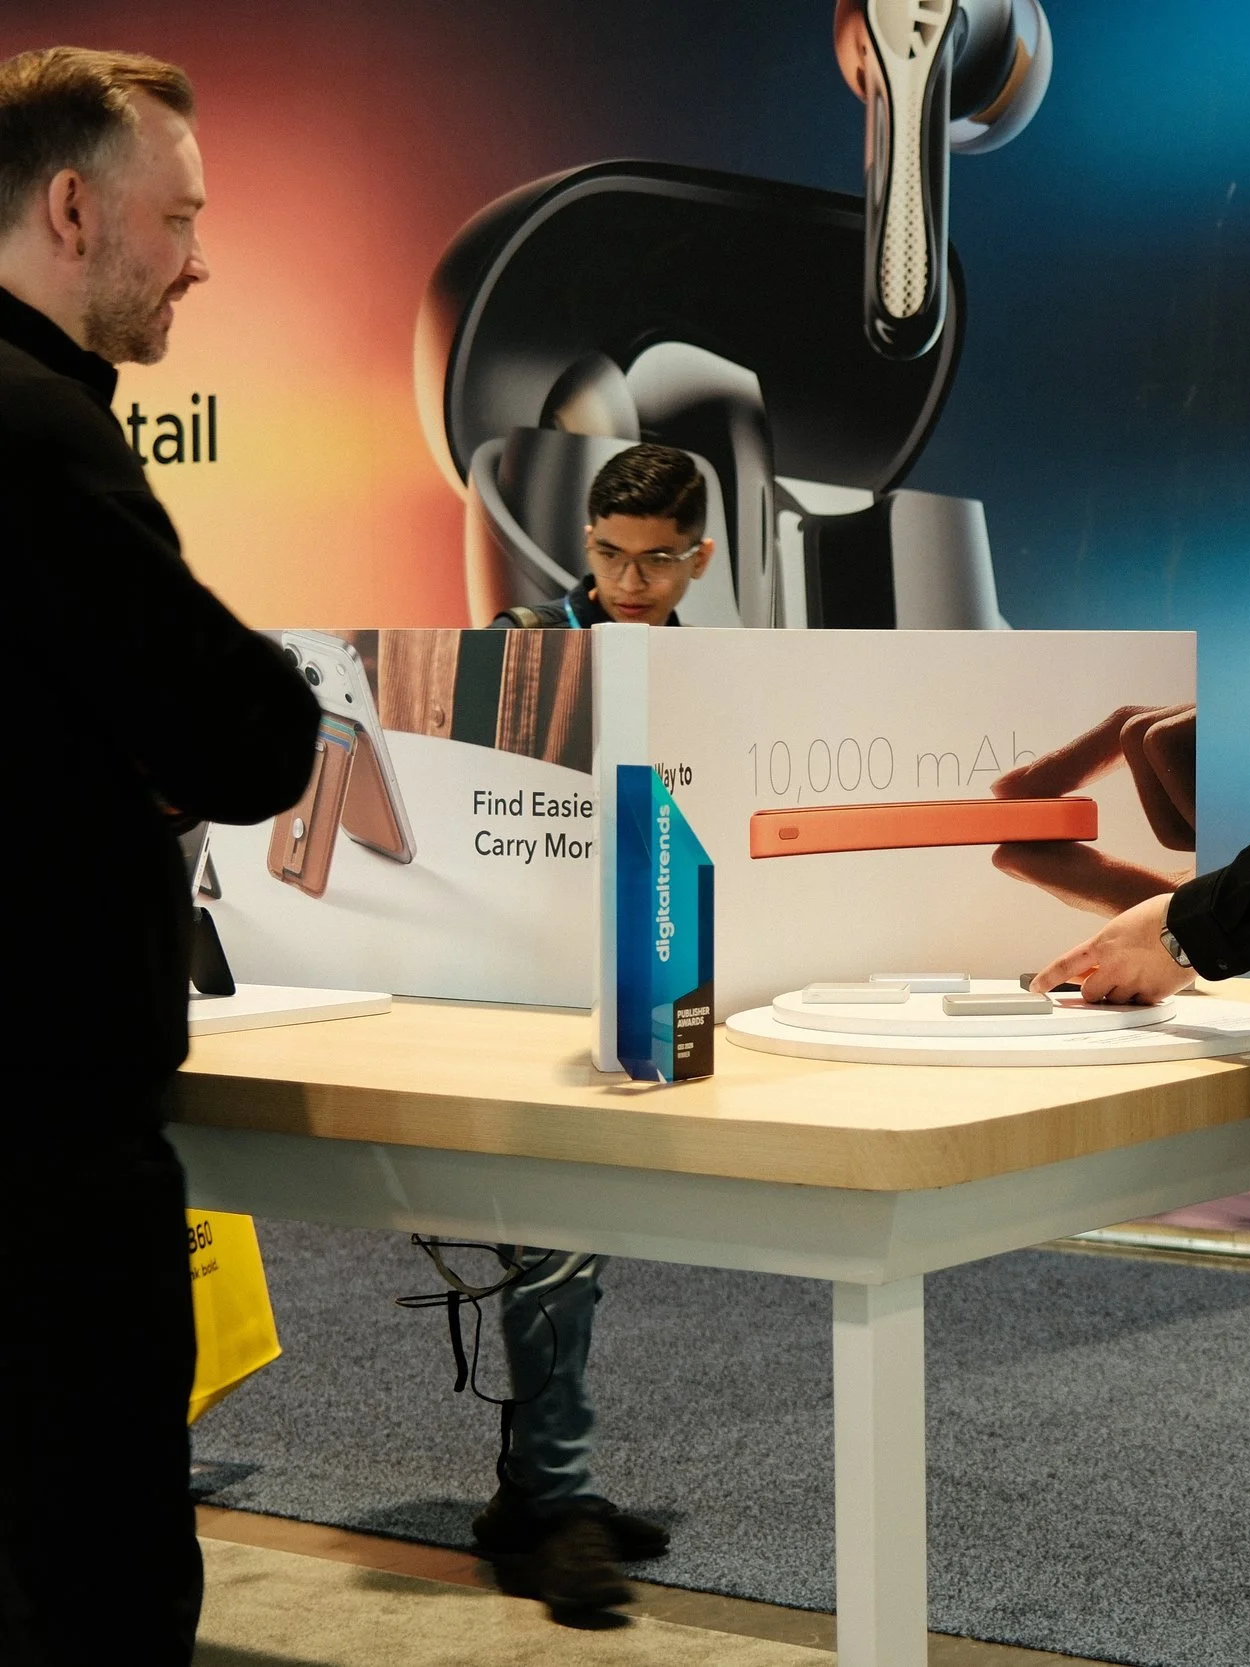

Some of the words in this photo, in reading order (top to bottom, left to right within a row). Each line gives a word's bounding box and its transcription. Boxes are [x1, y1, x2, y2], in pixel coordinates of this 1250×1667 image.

[679, 762, 692, 786] to
[748, 736, 894, 803] 10,000
[473, 790, 523, 816] Find
[532, 791, 593, 818] Easie
[475, 830, 537, 865] Carry
[545, 832, 593, 859] Mor
[656, 804, 675, 963] digitaltrends
[677, 1006, 710, 1018] PUBLISHER
[677, 1016, 705, 1028] AWARDS
